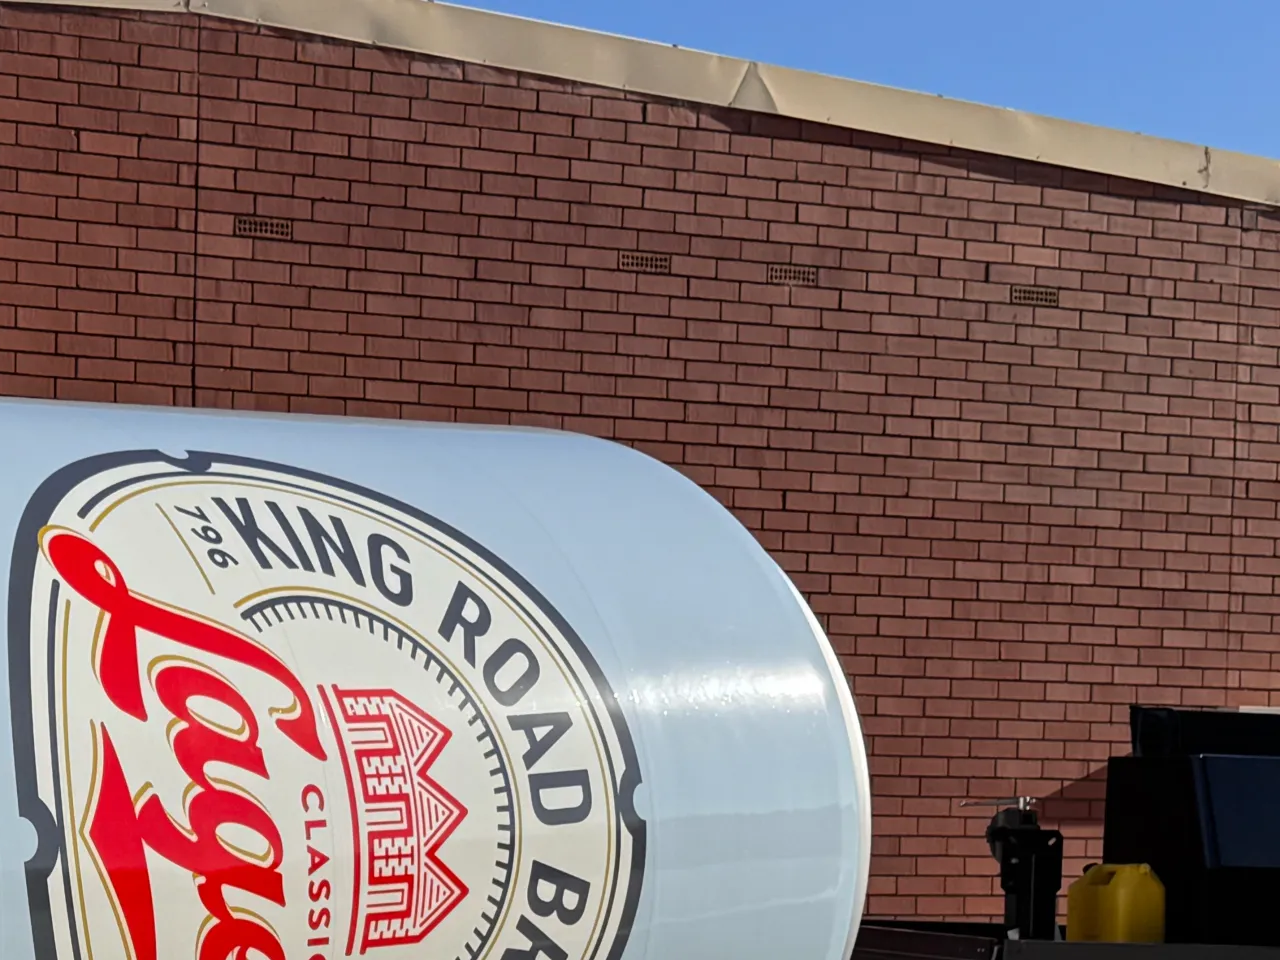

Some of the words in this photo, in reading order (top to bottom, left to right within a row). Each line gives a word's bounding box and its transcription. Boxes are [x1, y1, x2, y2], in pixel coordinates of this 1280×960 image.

[173, 504, 239, 569] 796
[210, 497, 413, 607] KING
[437, 579, 592, 826] ROAD
